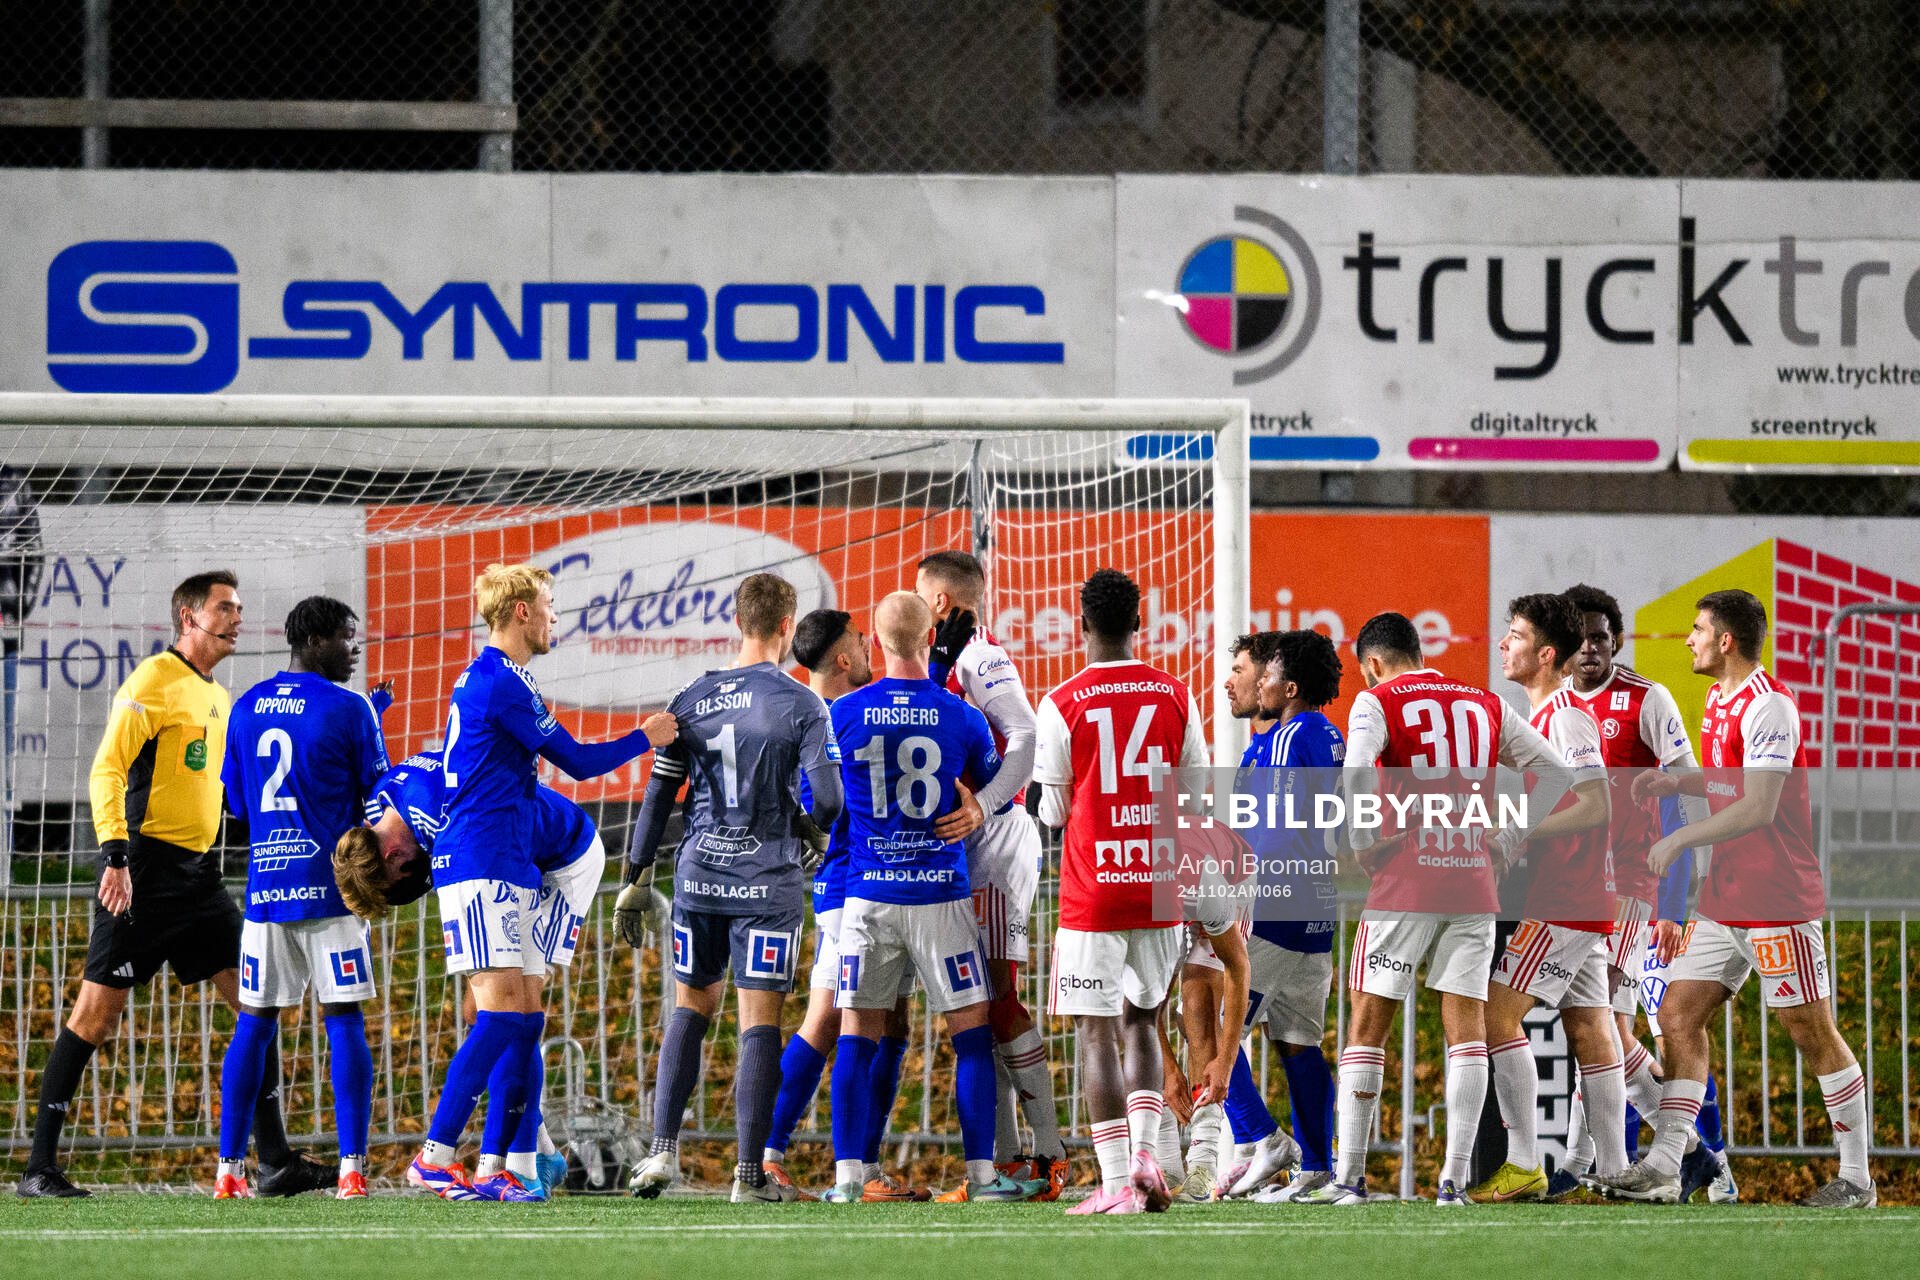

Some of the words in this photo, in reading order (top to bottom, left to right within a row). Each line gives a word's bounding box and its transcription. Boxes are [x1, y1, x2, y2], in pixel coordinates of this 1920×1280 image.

[1344, 217, 1920, 380] trycktr
[248, 281, 1065, 364] SYNTRONIC
[1471, 412, 1598, 437] digitaltryck
[1751, 416, 1877, 440] screentryck
[42, 556, 127, 607] AY
[1073, 681, 1174, 702] (LUNDBERG&CO)
[254, 697, 306, 715] OPPONG
[695, 691, 753, 716] OLSSON
[864, 707, 939, 726] FORSBERG
[1085, 704, 1172, 794] 14
[1401, 699, 1491, 781] 30
[256, 727, 298, 813] 2
[705, 723, 739, 808] 1
[854, 735, 942, 820] 18
[1111, 803, 1161, 828] LAGUE
[253, 844, 307, 858] SUNDFRAKT
[863, 869, 955, 883] BILBOLAGET
[1096, 869, 1176, 884] clockwork
[251, 886, 328, 906] BILBOLAGET
[684, 879, 769, 899] BILBOLAGET
[1009, 921, 1028, 942] gibo
[1368, 952, 1412, 975] gibon
[1539, 961, 1573, 983] gibon
[1059, 973, 1103, 996] gibon
